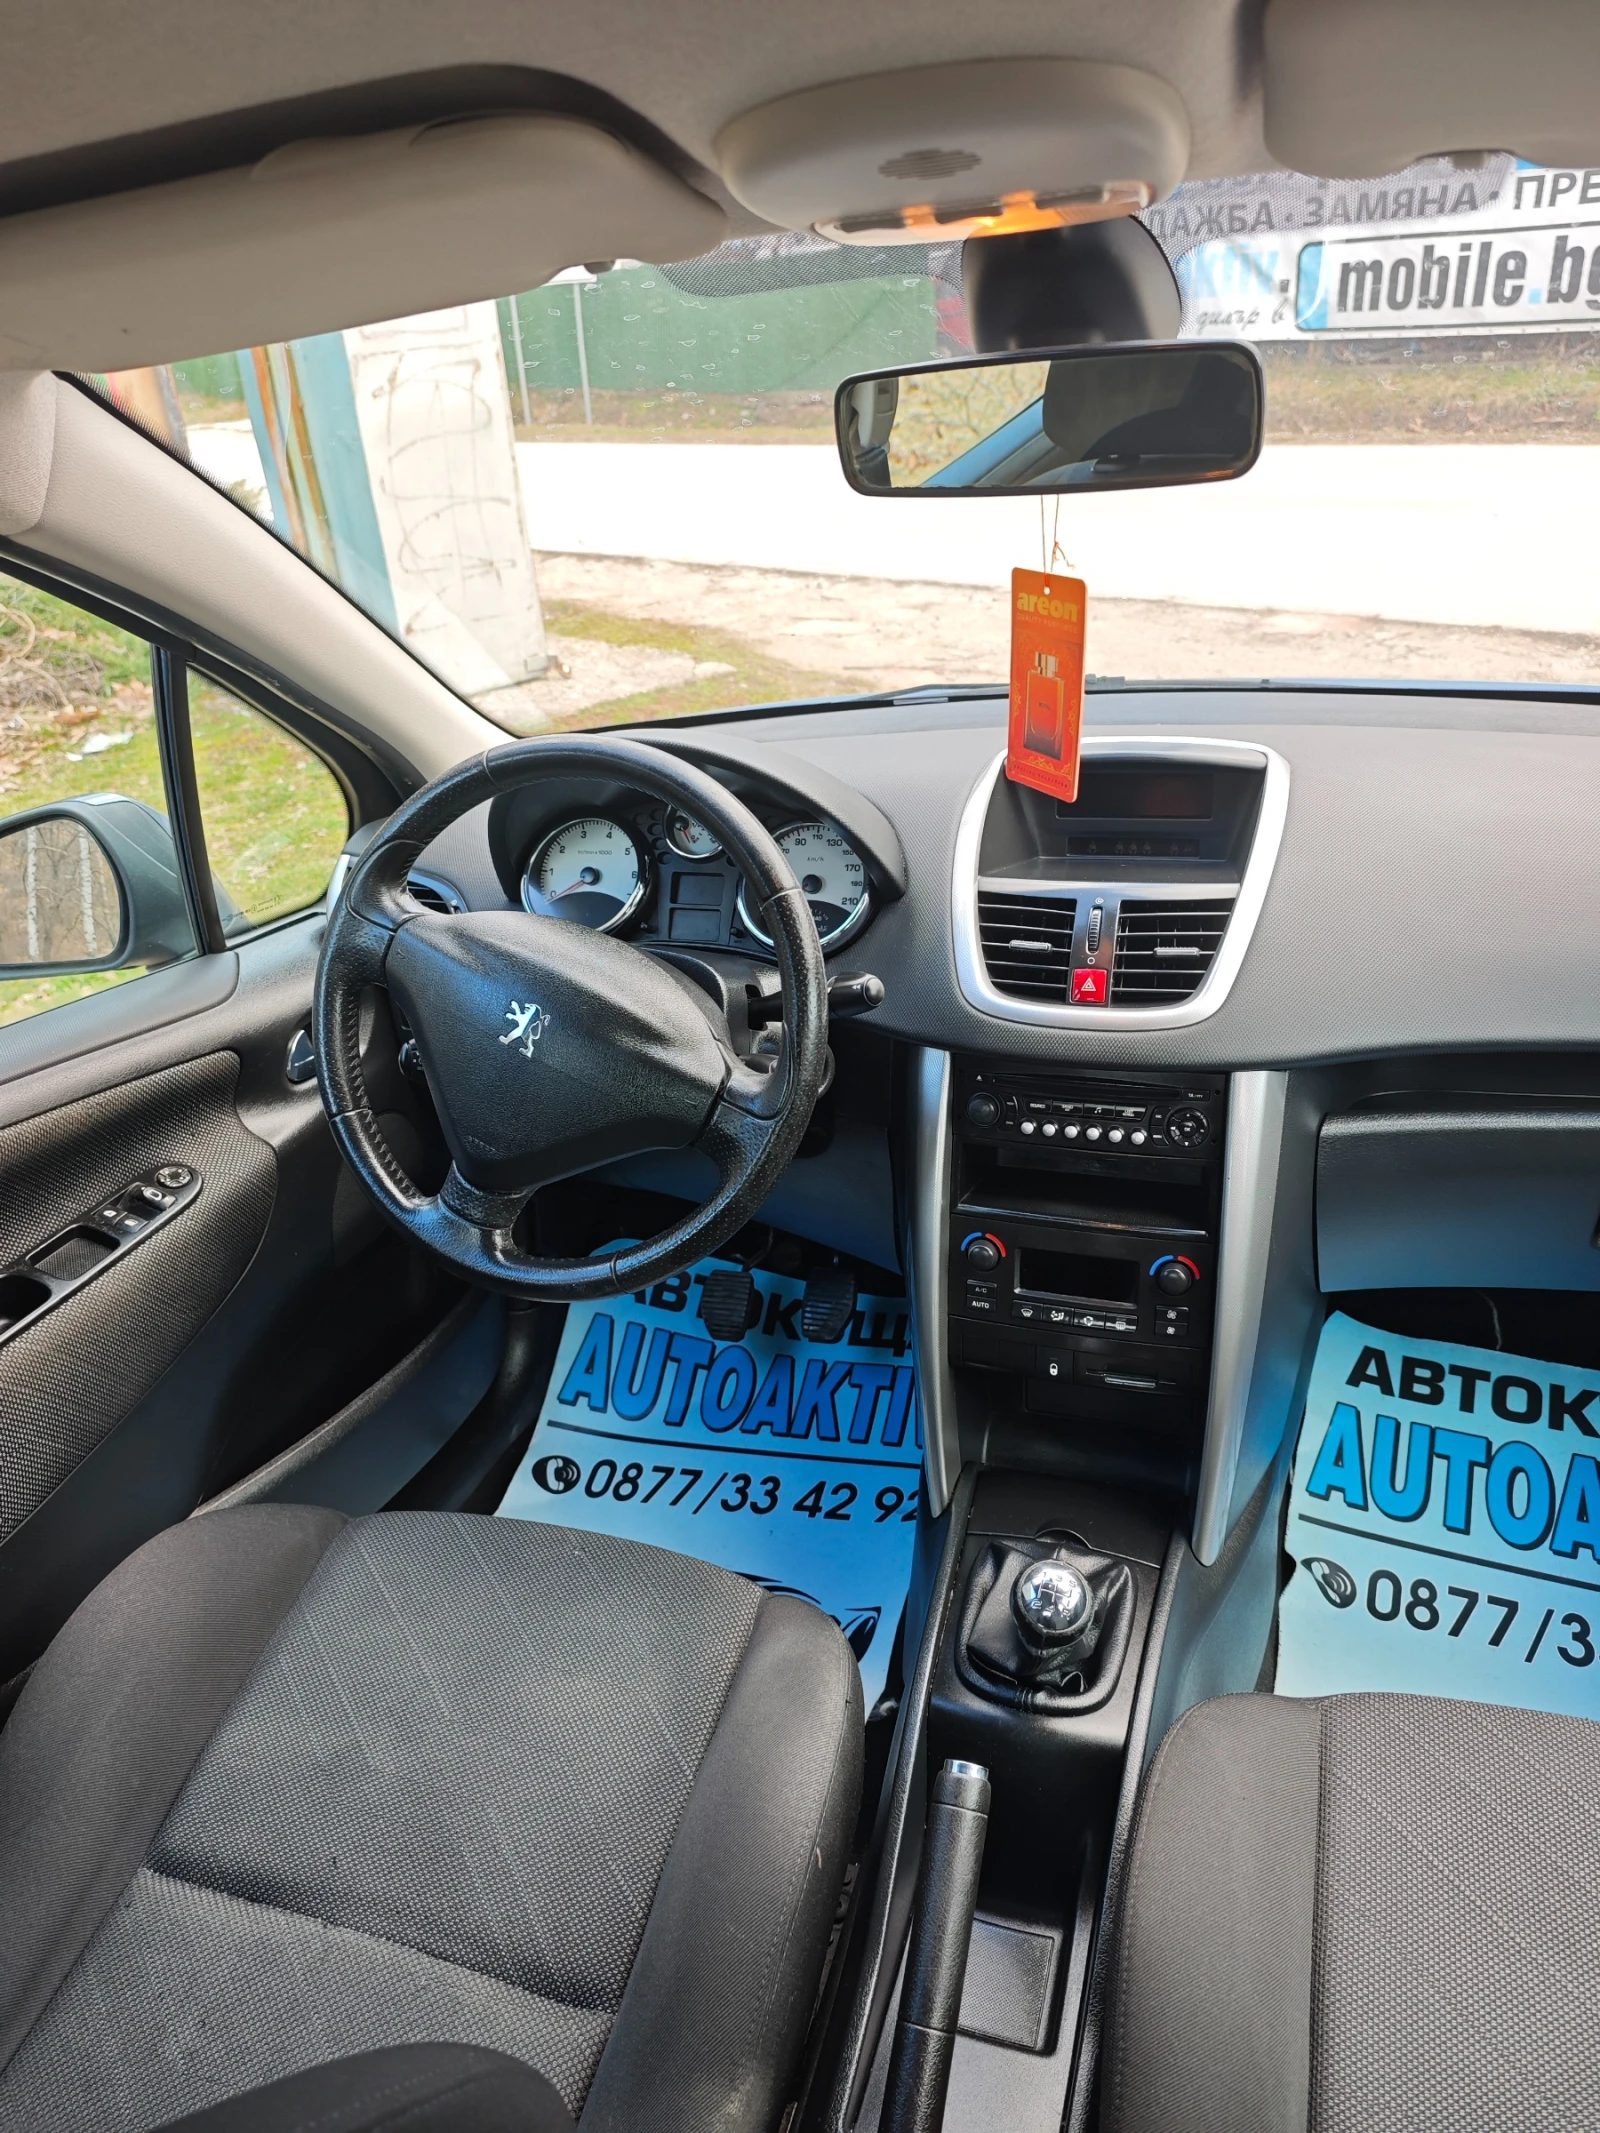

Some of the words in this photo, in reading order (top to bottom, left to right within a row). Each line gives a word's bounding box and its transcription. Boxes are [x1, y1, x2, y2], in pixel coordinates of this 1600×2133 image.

[1303, 182, 1478, 226] ЗАМЯНА
[1016, 592, 1078, 623] areon
[580, 830, 587, 839] 3
[606, 831, 612, 839] 4
[795, 838, 807, 846] 90
[826, 839, 843, 847] 130
[559, 845, 566, 854] 2
[624, 847, 631, 856] 5
[549, 868, 554, 876] 1
[844, 864, 861, 872] 170
[631, 871, 638, 879] 6
[841, 897, 858, 906] 210
[972, 1300, 990, 1309] AUTO
[557, 1312, 924, 1450] AUTOAKTI
[1345, 1345, 1600, 1439] АВТОК
[584, 1459, 781, 1515] 0877/33
[793, 1480, 858, 1521] 42
[1030, 1598, 1042, 1609] 2
[1366, 1569, 1600, 1668] 0877/3
